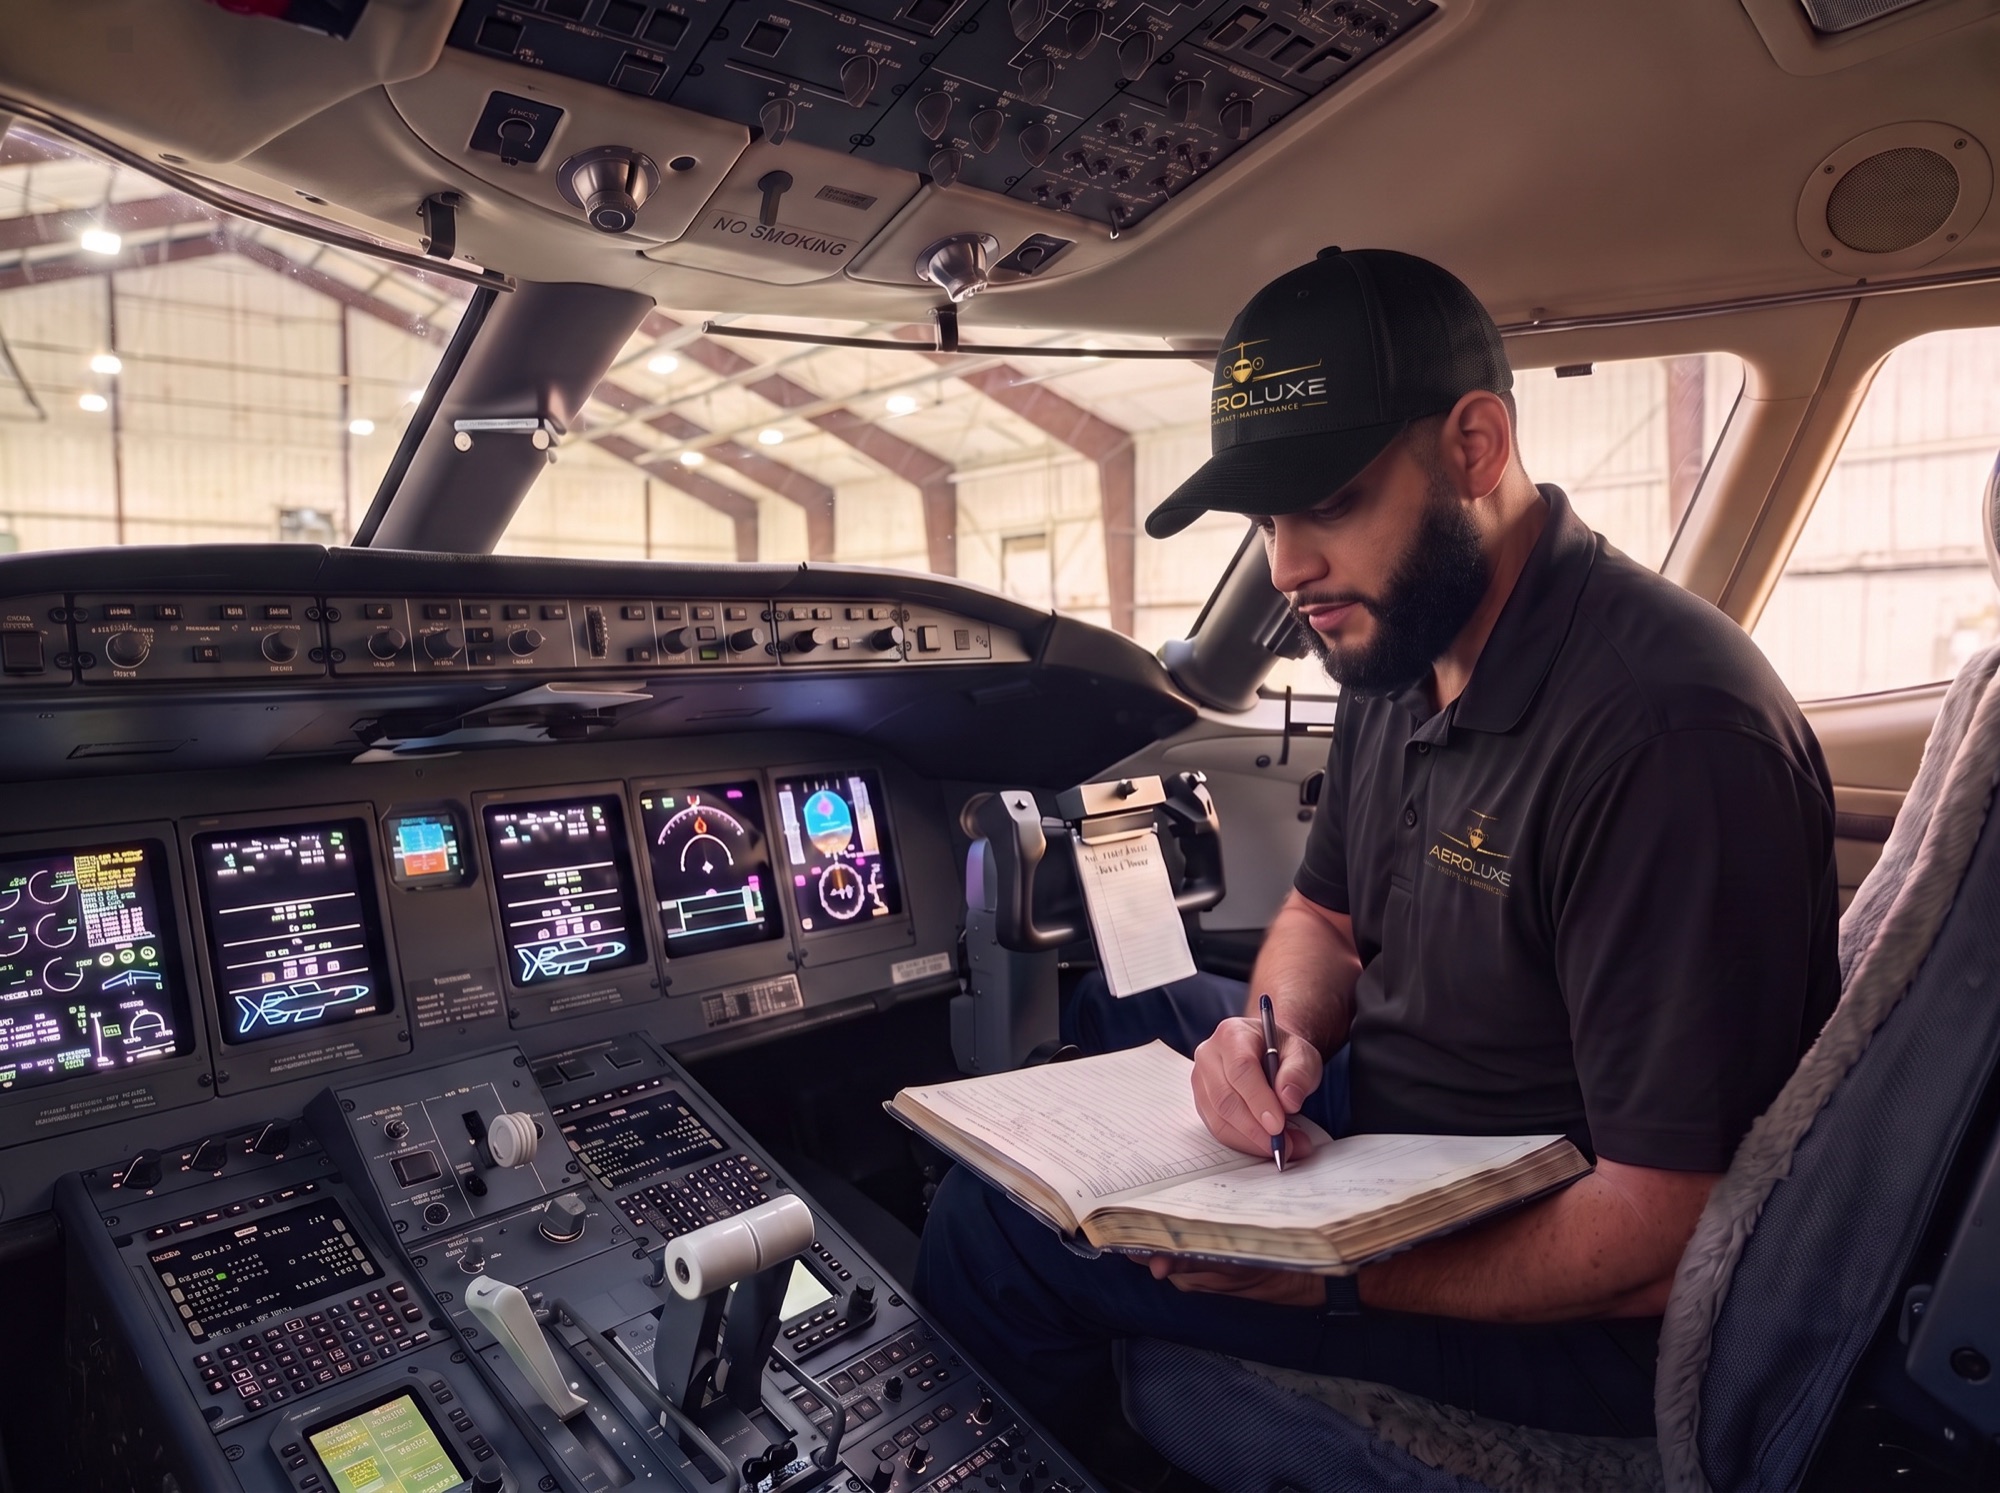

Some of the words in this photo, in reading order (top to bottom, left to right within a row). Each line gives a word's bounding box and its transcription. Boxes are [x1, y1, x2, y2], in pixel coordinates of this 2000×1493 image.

[713, 216, 748, 234] NO
[750, 225, 847, 256] SMOKING
[1211, 377, 1327, 416] EROLUXE
[1239, 402, 1299, 418] MAINTENANCE
[1429, 844, 1512, 887] AEROLUXE
